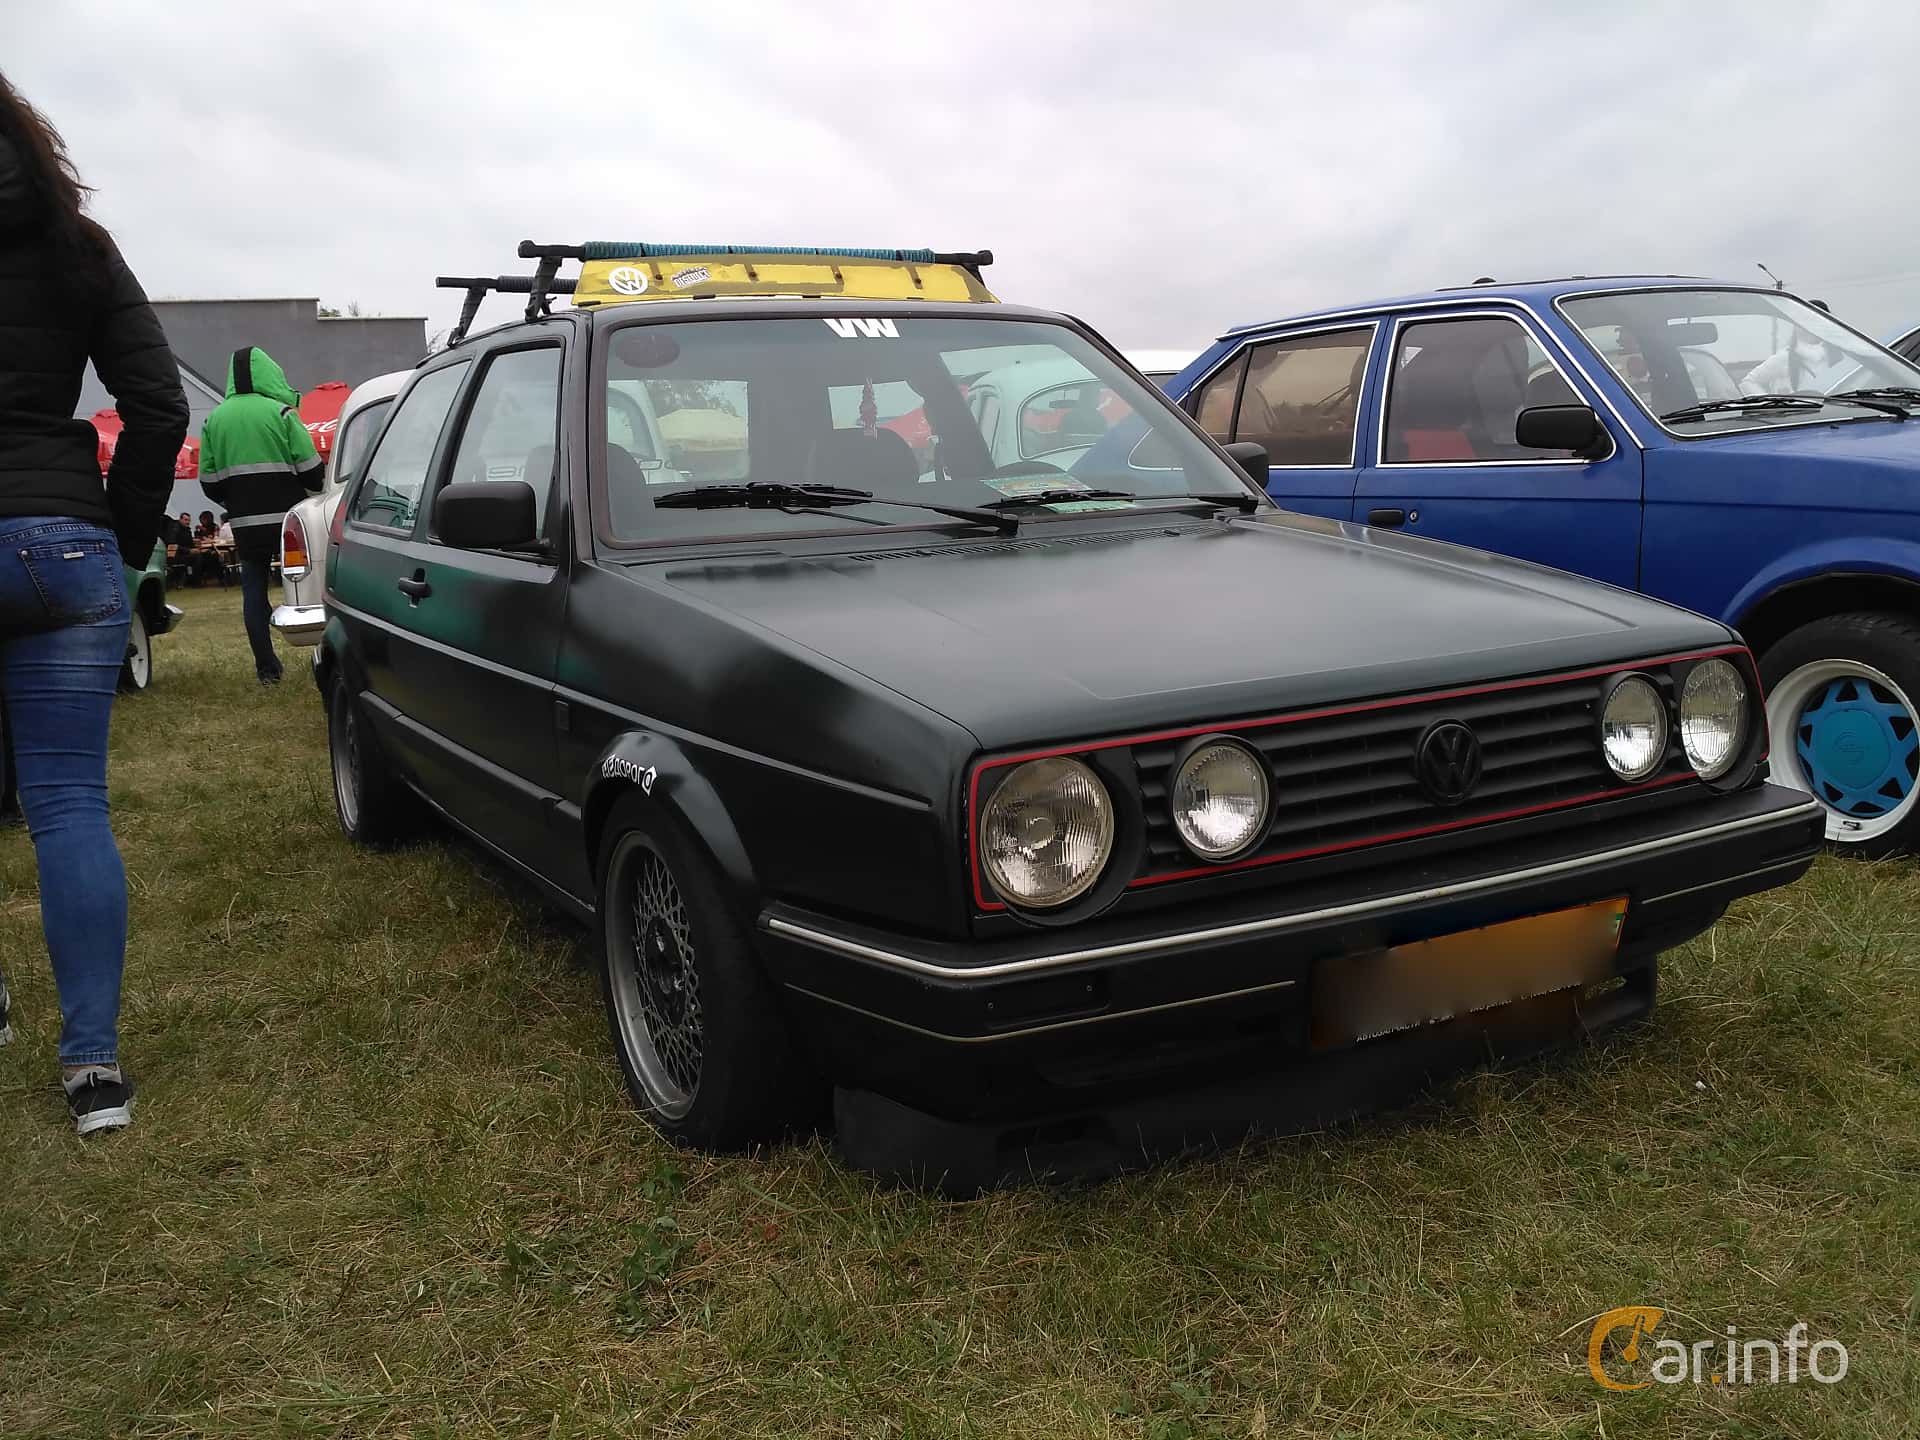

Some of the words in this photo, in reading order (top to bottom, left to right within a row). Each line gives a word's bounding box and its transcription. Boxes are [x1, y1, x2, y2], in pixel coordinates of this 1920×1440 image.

[609, 267, 648, 295] VW
[822, 318, 901, 338] VW
[1418, 720, 1480, 802] VW
